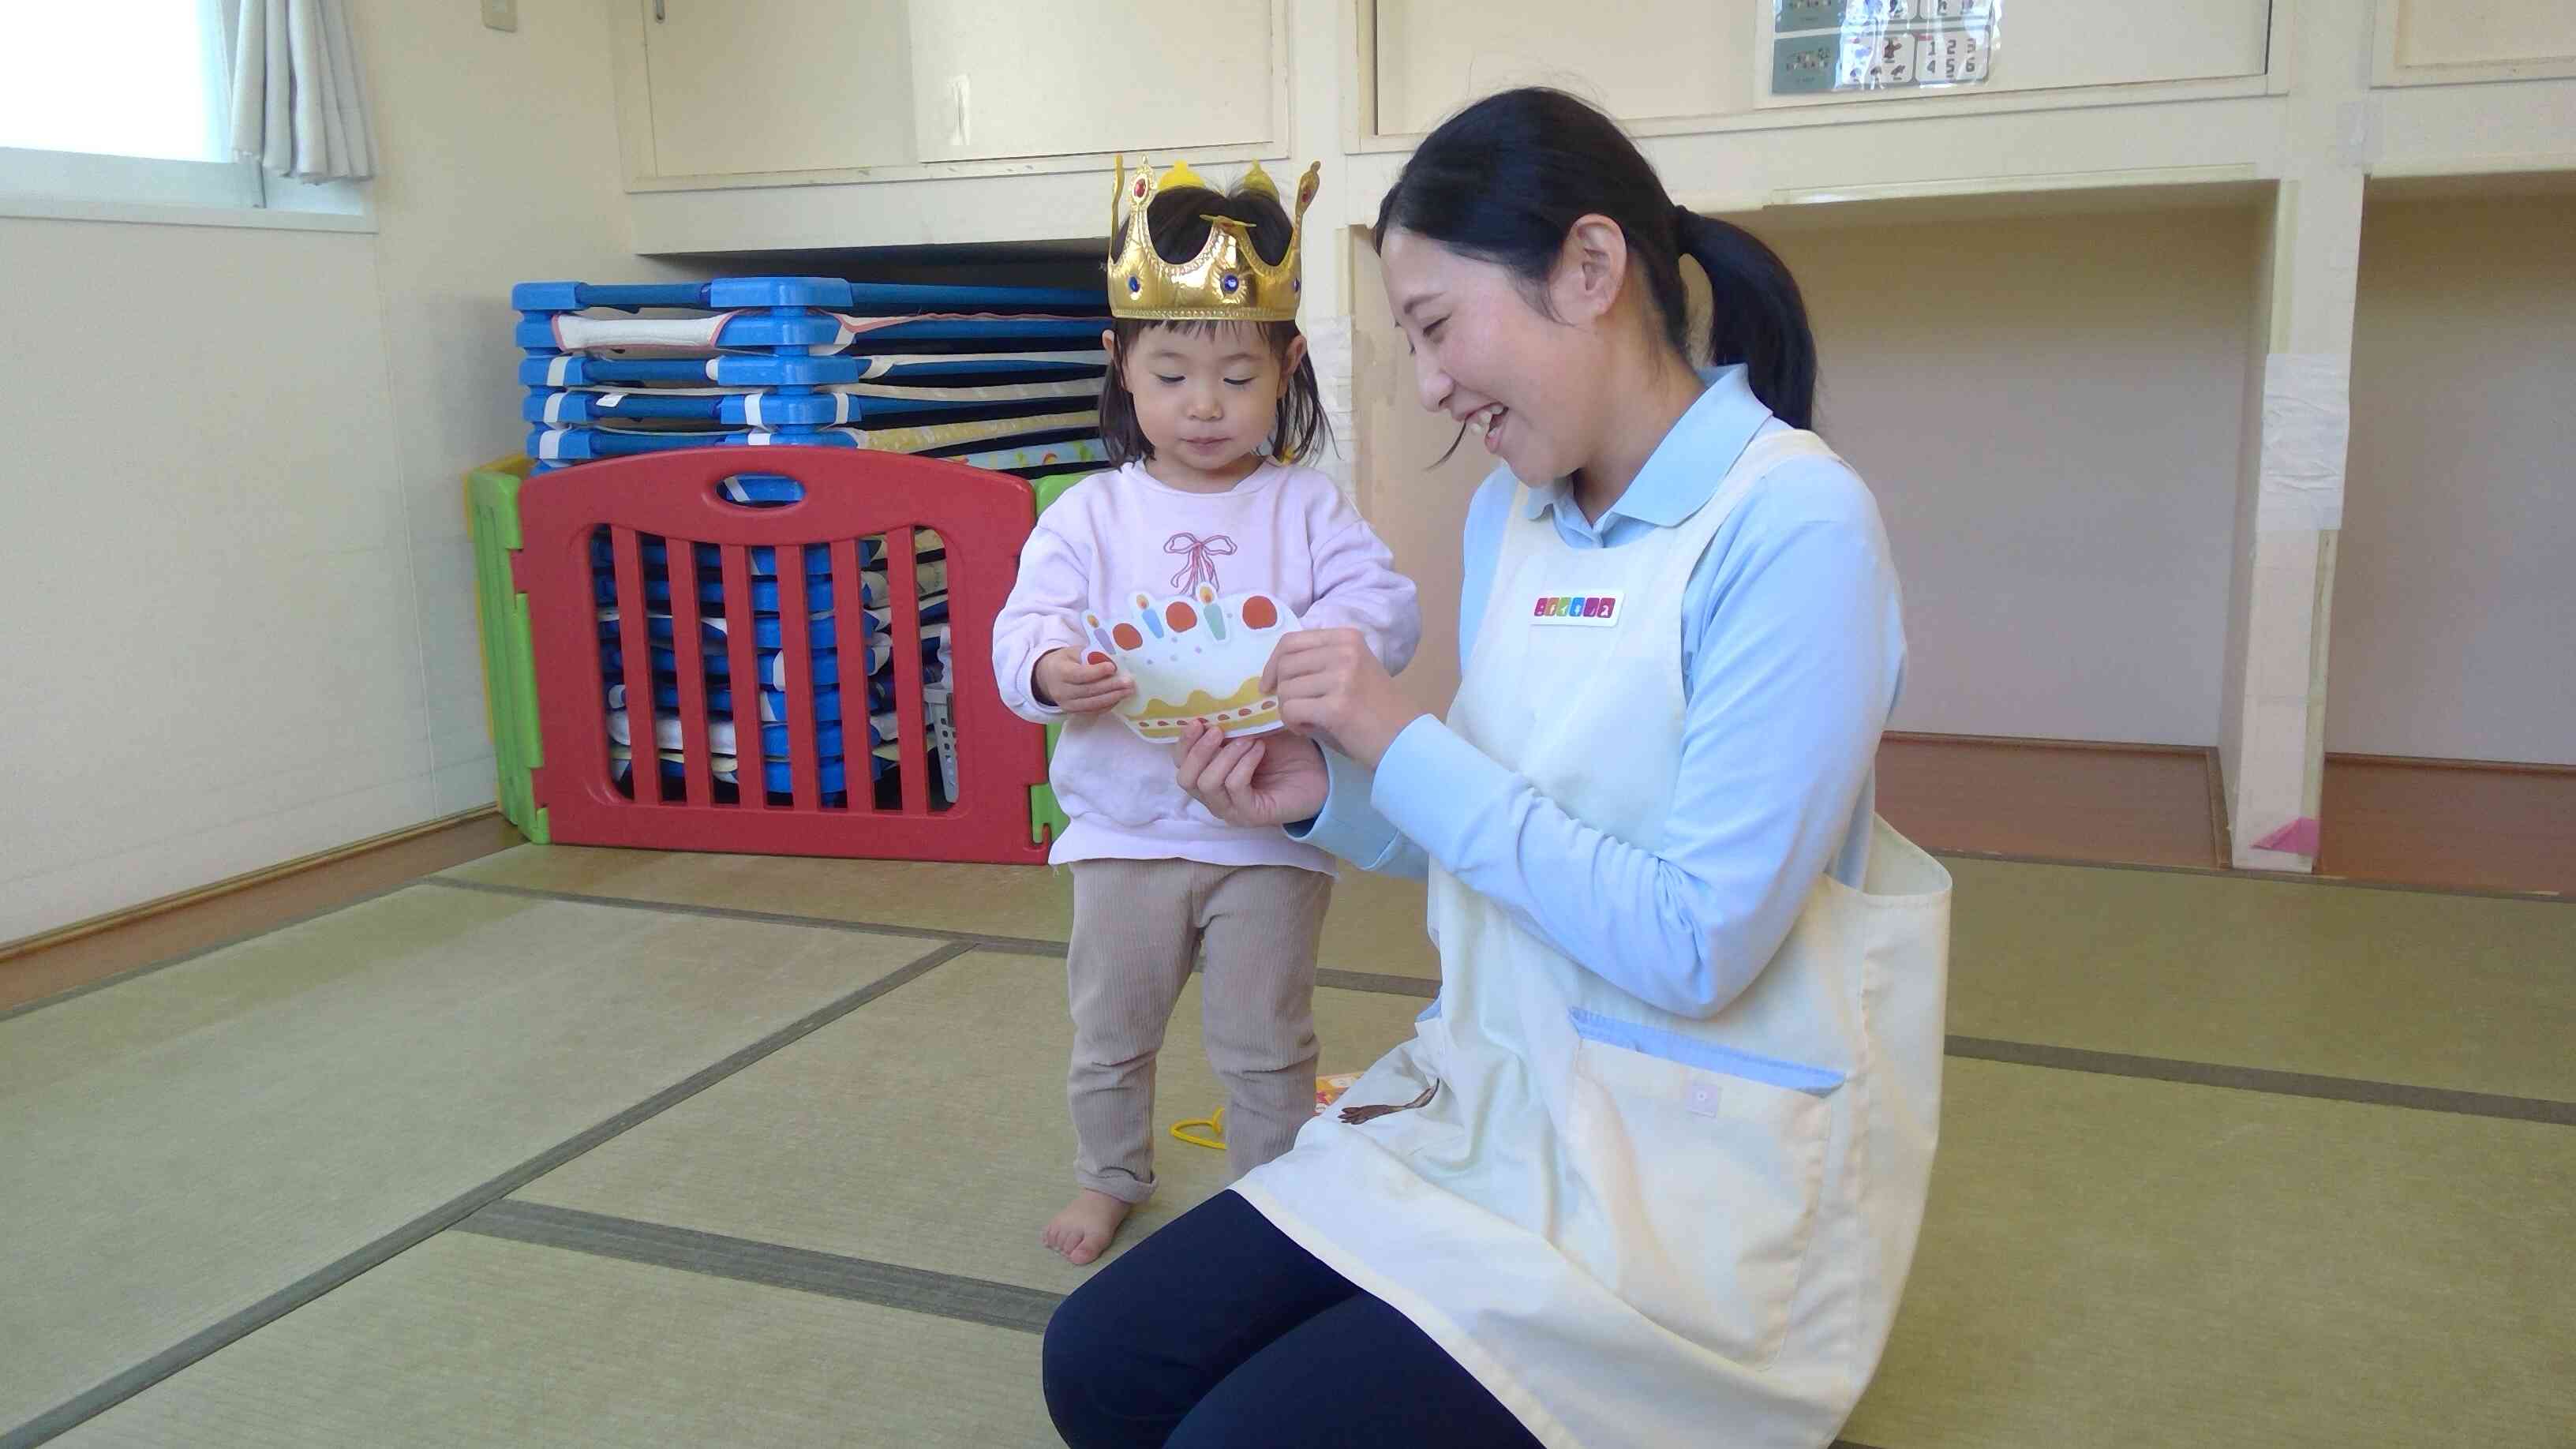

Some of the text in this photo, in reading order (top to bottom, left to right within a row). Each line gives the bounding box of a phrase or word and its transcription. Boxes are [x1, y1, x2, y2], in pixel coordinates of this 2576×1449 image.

[1928, 41, 1936, 55] 1
[1947, 39, 1956, 54] 2
[1926, 57, 1975, 73] 4 5 6
